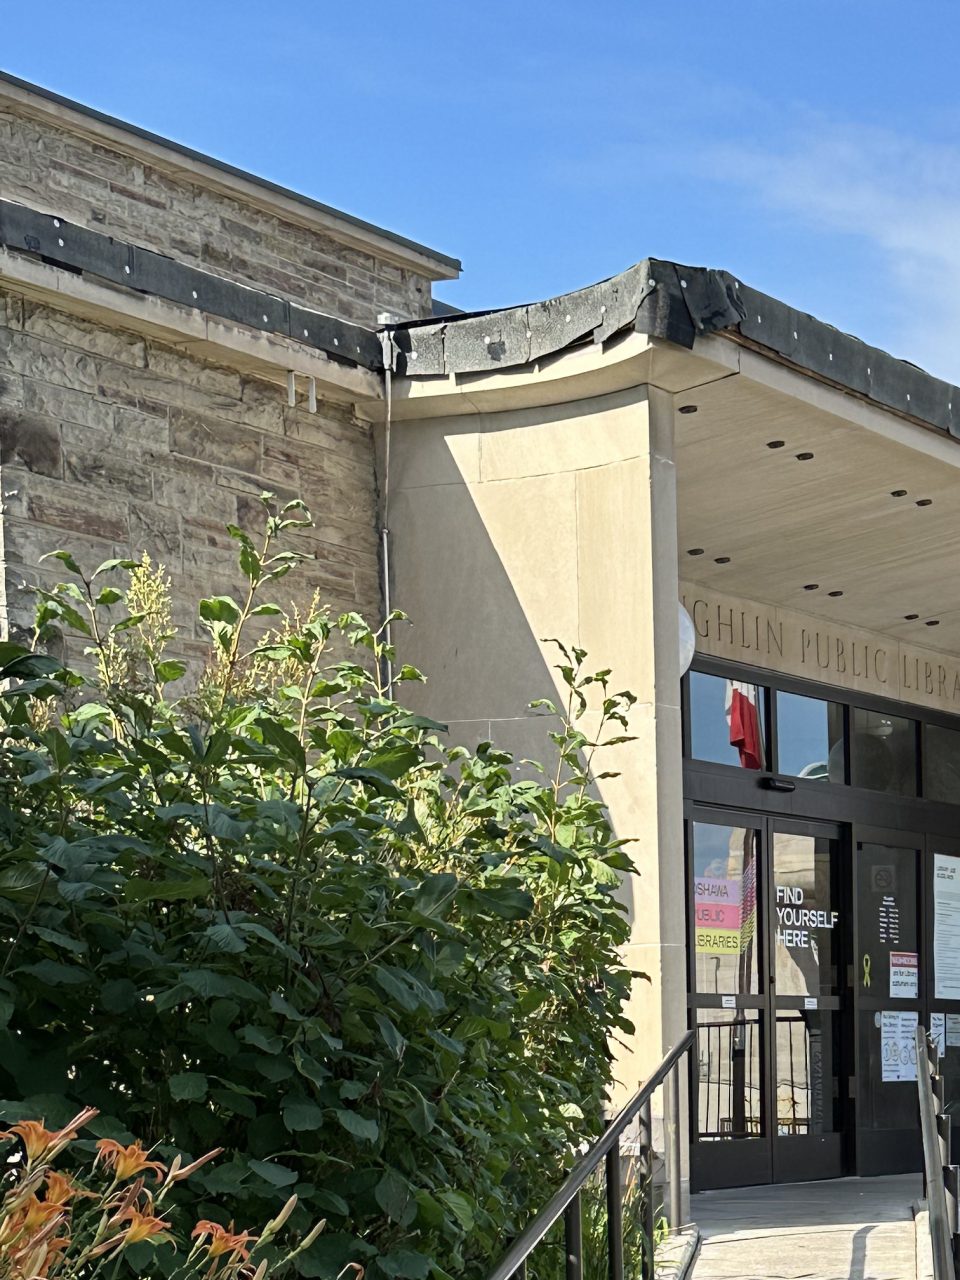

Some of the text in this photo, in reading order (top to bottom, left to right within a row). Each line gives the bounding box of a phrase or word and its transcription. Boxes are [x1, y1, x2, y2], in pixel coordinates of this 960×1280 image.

[682, 595, 783, 657] GHLIN
[801, 629, 887, 683] PUBLIC
[695, 882, 729, 898] SHAWA
[776, 886, 804, 905] FIND
[776, 907, 839, 929] YOURSELF
[776, 925, 809, 948] HERE
